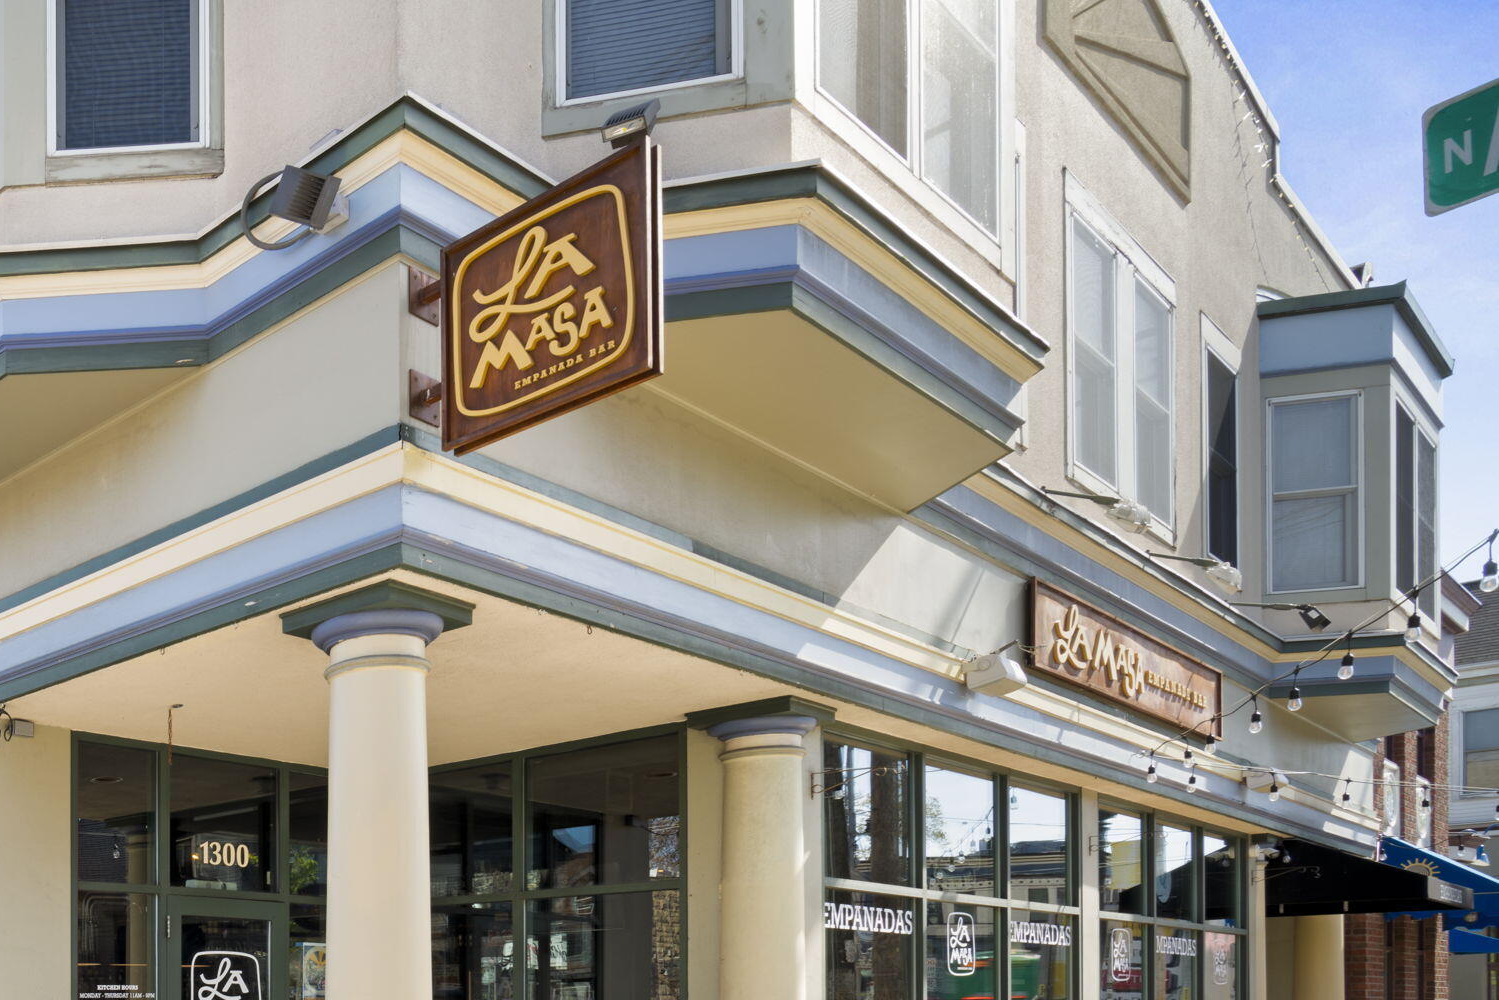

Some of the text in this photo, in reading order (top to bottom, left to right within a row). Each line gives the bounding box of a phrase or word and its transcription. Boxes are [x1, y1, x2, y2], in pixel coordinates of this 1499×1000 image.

[1444, 129, 1473, 174] N
[469, 226, 596, 343] LA
[470, 286, 614, 389] MASA
[514, 340, 616, 390] EMPANADA BAR
[1053, 604, 1092, 670] LA
[1092, 628, 1146, 697] MASA
[200, 840, 250, 868] 1300
[824, 902, 913, 935] EMPANADAS
[949, 917, 971, 948] LA
[949, 948, 973, 966] MASA
[1155, 935, 1197, 957] MPANADAS
